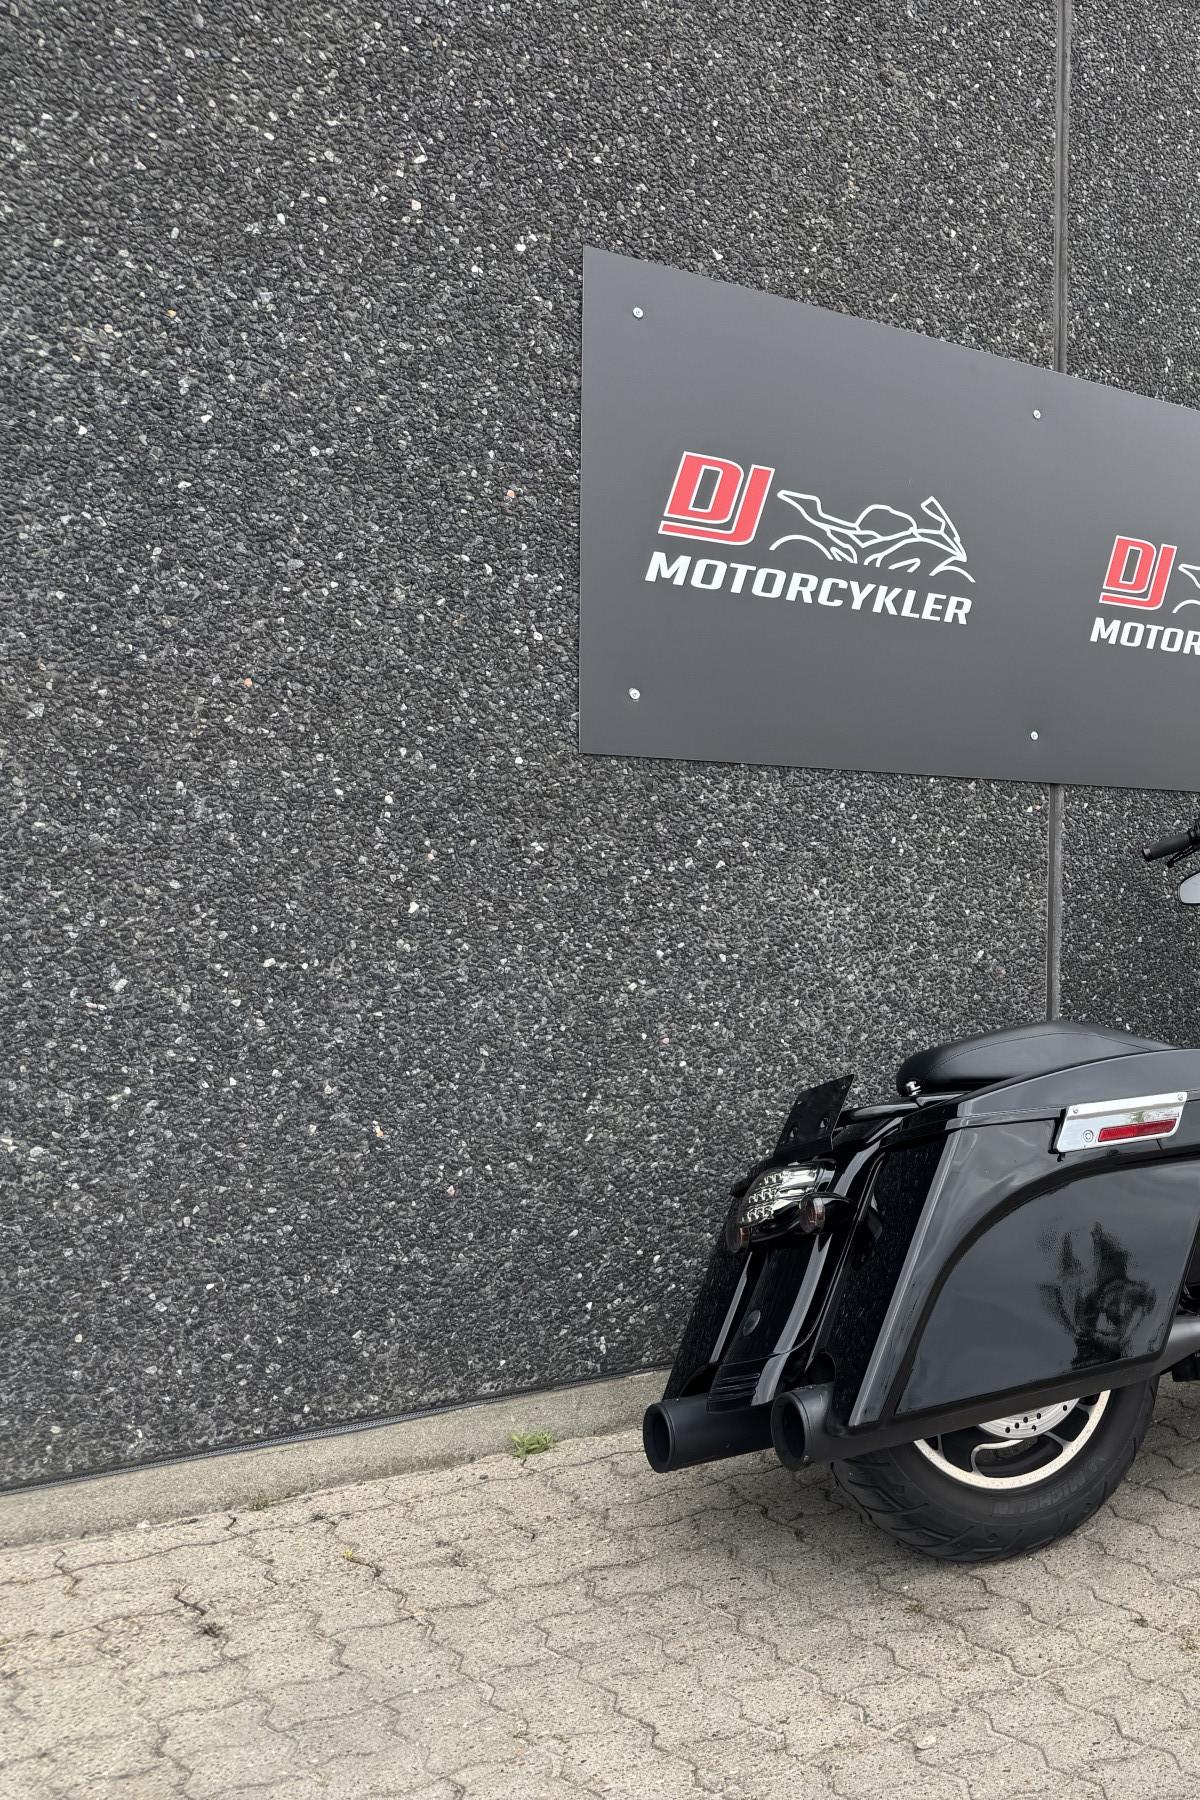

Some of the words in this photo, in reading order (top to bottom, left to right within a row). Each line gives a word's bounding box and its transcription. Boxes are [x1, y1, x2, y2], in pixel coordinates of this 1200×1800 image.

[658, 451, 776, 545] DJ
[645, 551, 973, 625] MOTORCYKLER
[1099, 534, 1178, 610] DJ
